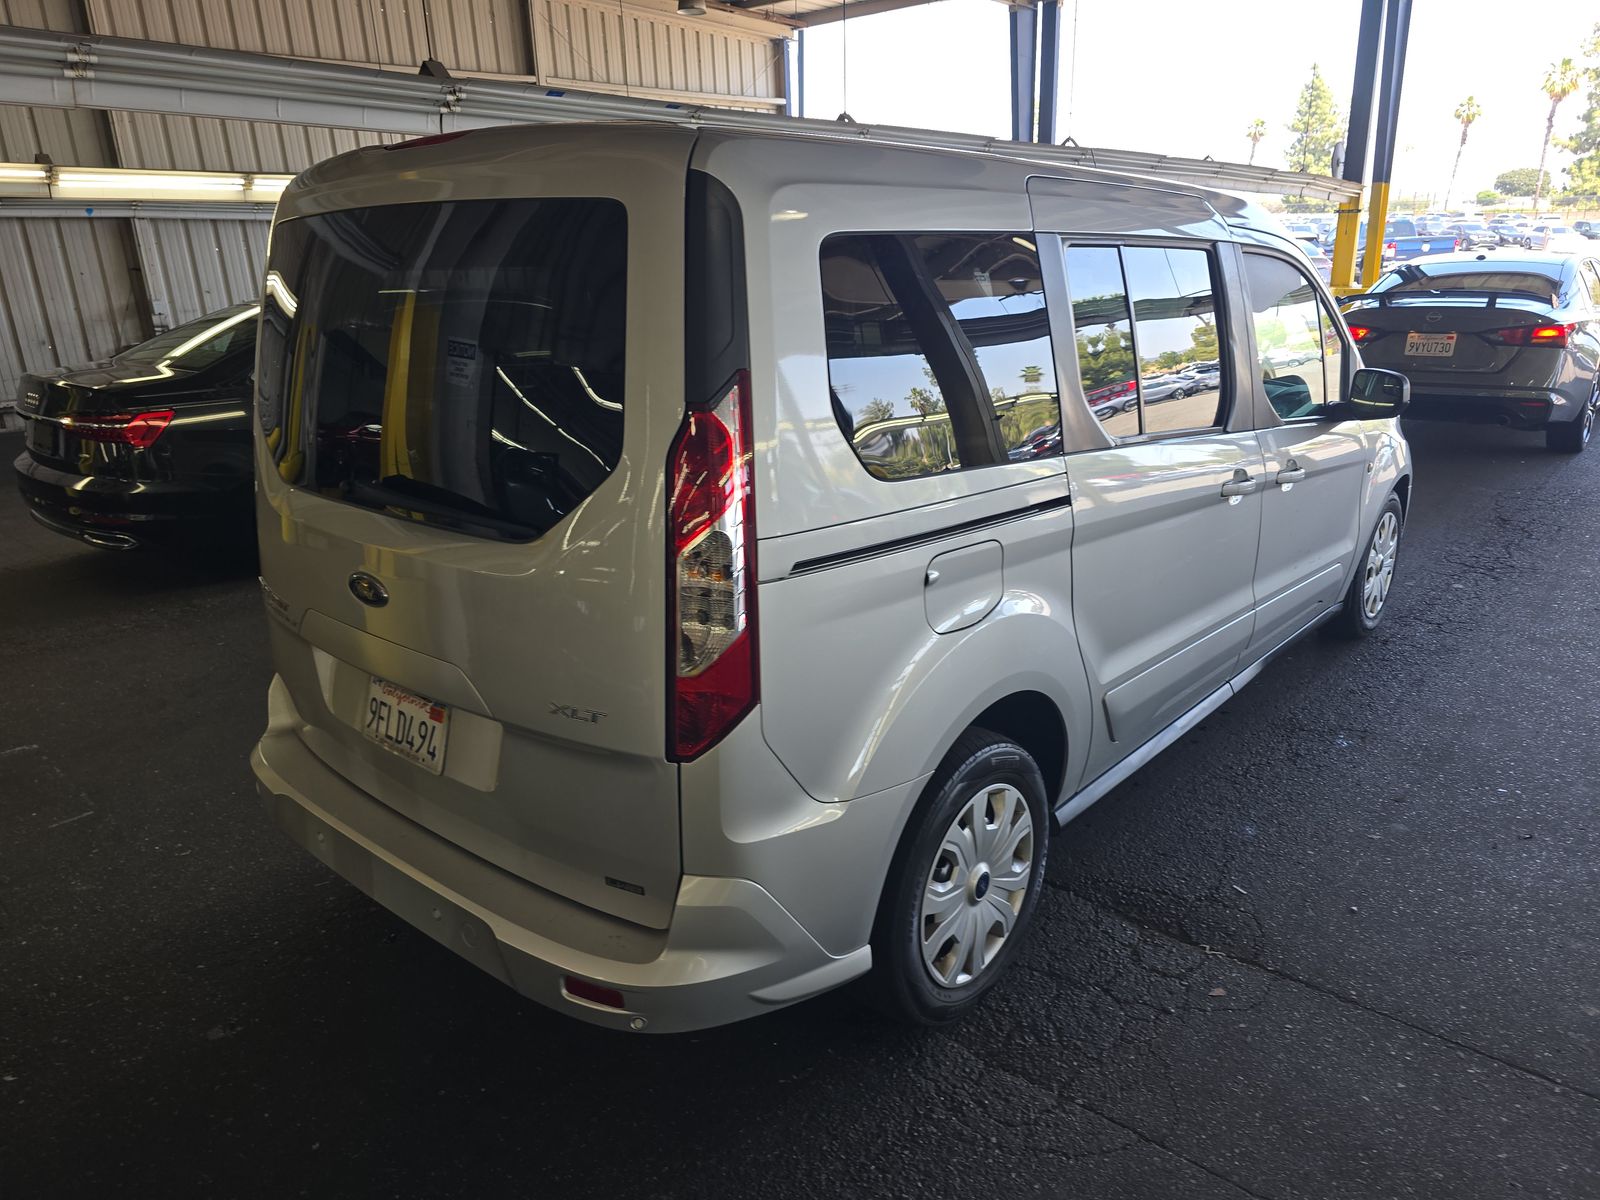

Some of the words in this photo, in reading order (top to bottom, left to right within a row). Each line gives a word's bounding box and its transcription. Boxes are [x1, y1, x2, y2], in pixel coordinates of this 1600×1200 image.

[1408, 342, 1452, 353] 9VYU730
[549, 702, 608, 723] XLT
[366, 697, 437, 761] 9FLD494
